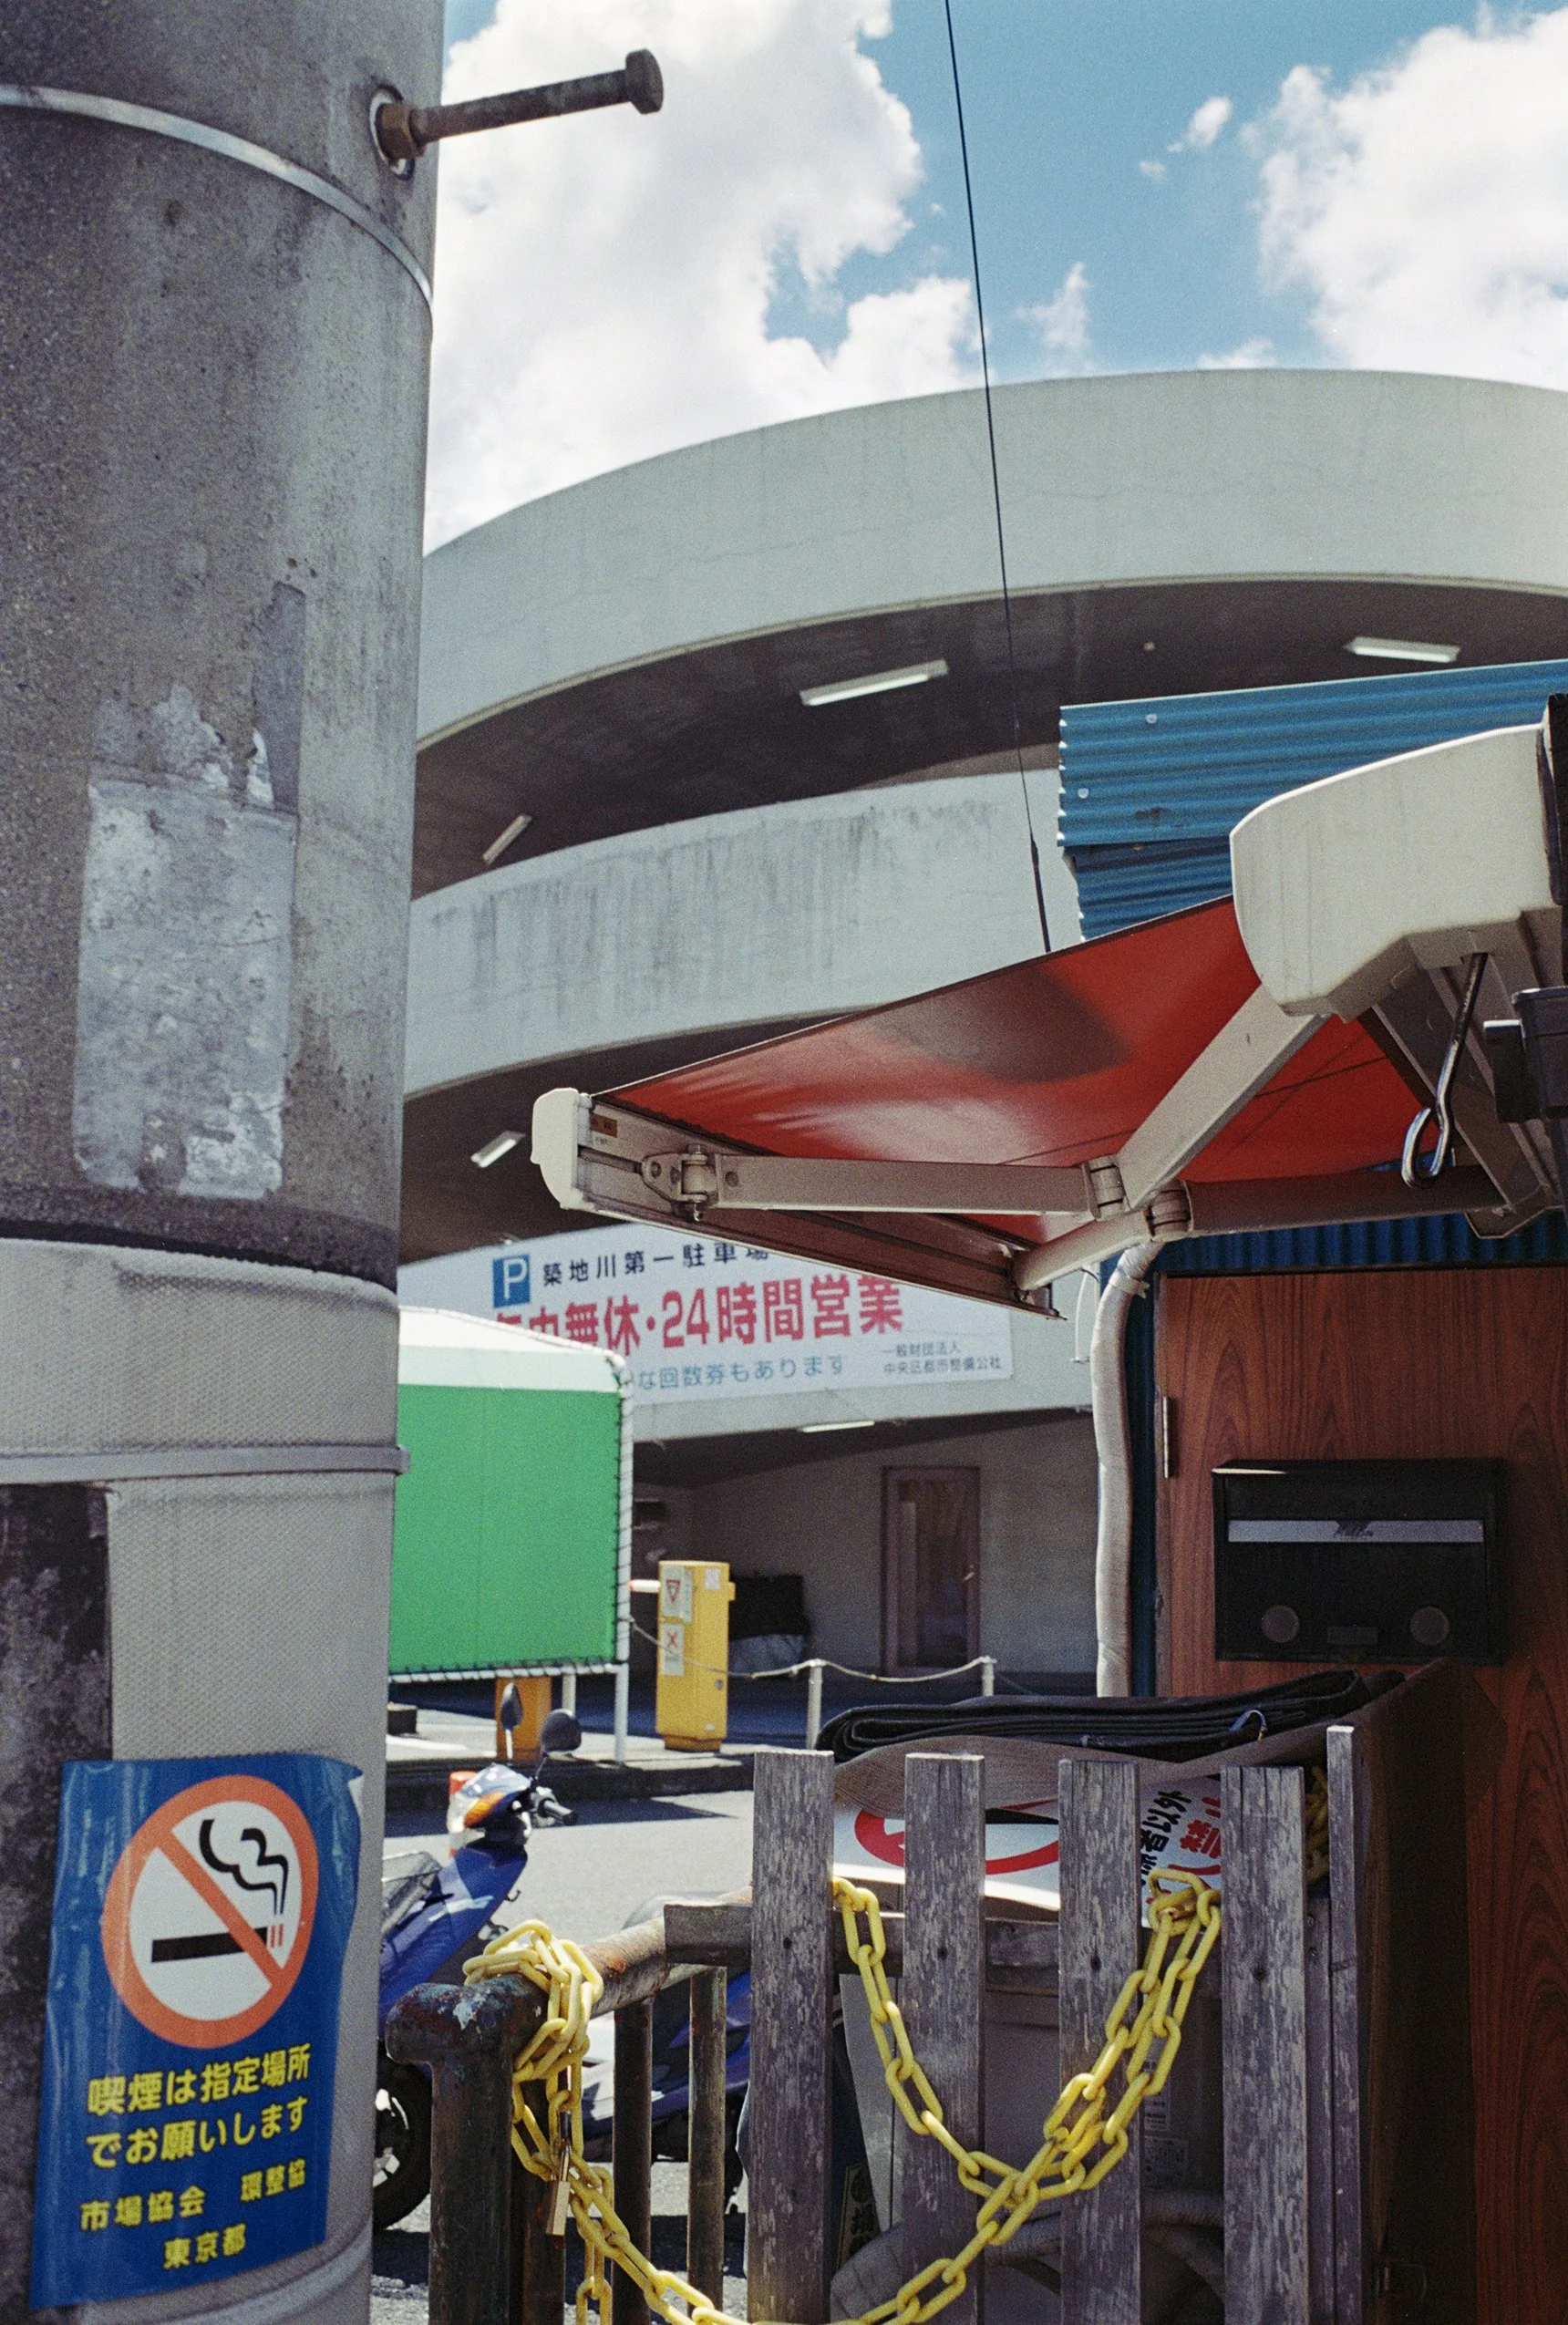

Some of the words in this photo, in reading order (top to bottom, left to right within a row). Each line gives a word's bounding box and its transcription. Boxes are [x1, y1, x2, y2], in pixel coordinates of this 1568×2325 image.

[503, 1257, 528, 1300] P
[87, 2042, 311, 2116] 喫煙は指定場所
[86, 2095, 308, 2168] でお願いします
[79, 2185, 206, 2231] 市場協会
[162, 2223, 246, 2269] 東京都
